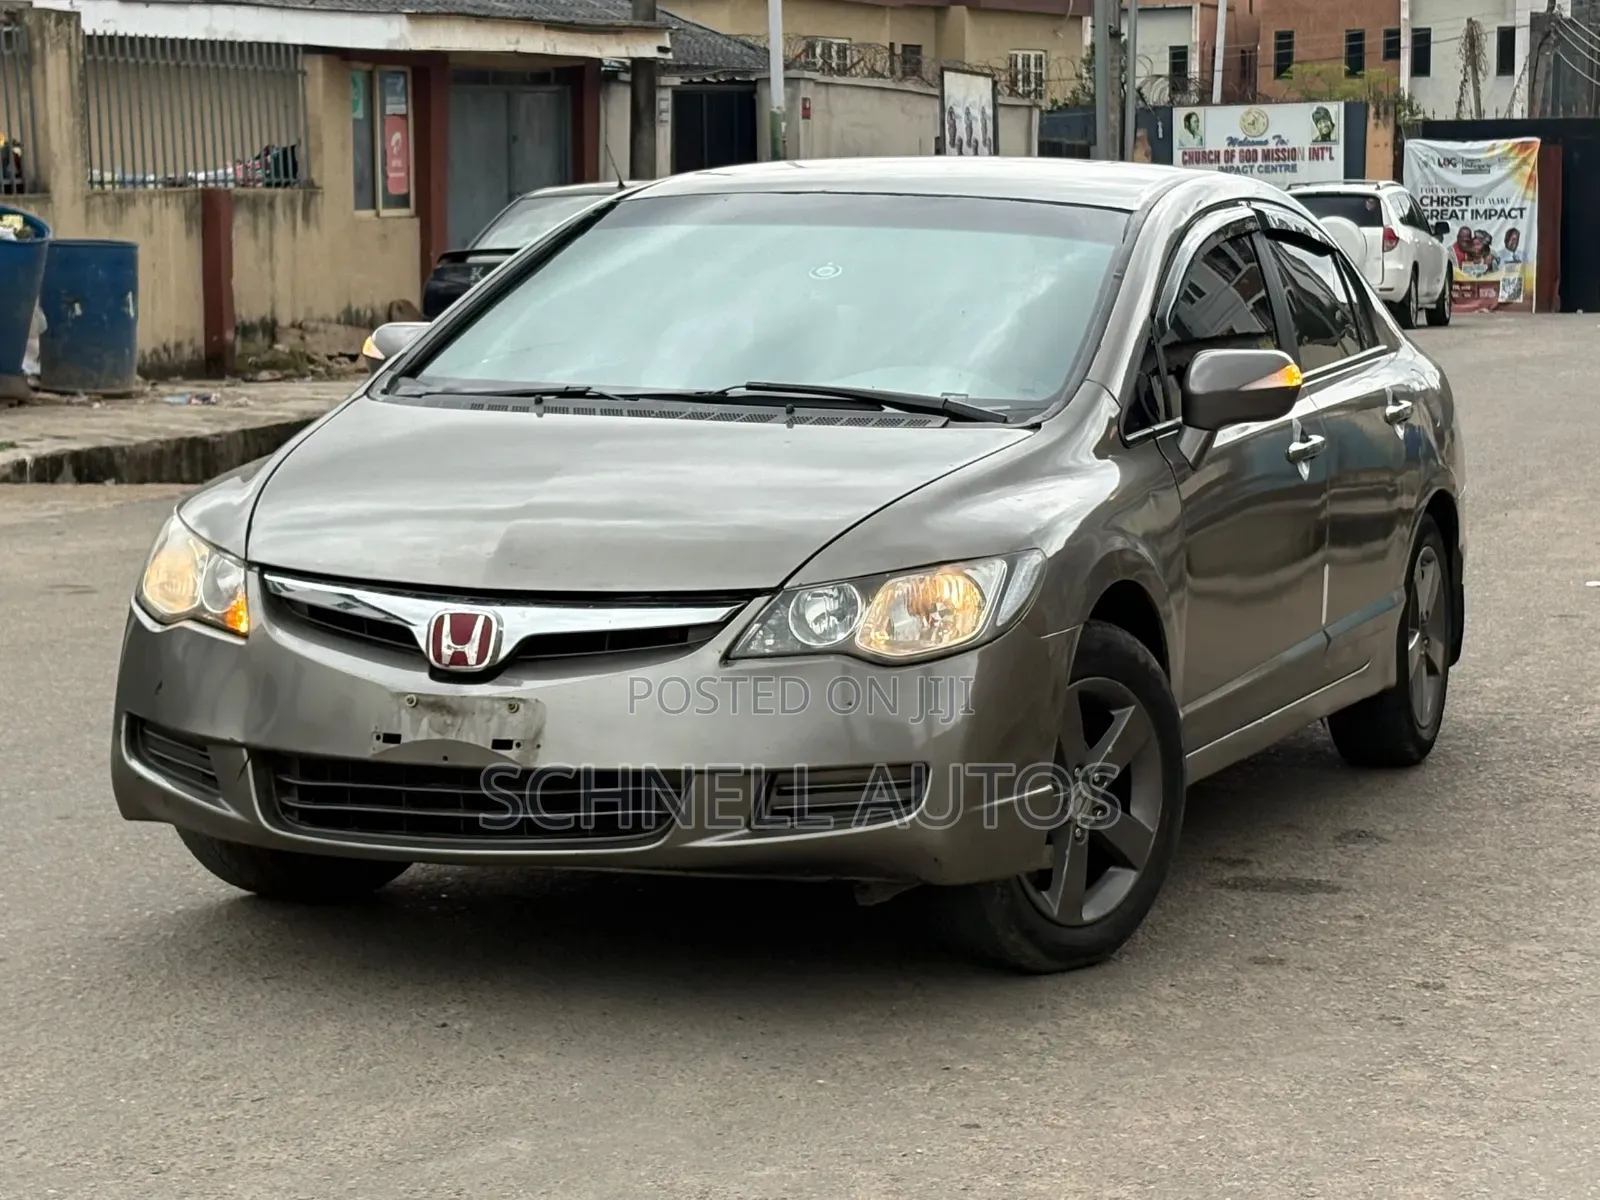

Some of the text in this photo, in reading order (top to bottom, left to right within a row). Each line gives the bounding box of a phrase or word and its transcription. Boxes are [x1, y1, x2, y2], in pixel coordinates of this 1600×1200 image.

[1225, 136, 1269, 147] Welcome
[1181, 148, 1221, 165] CHURCH
[1223, 148, 1236, 164] OF
[1239, 148, 1258, 164] GOD
[1308, 146, 1335, 162] INT'L
[1217, 163, 1298, 175] IMPACT CENTRE
[1419, 195, 1472, 207] CHRIST
[1470, 207, 1527, 221] IMPACT
